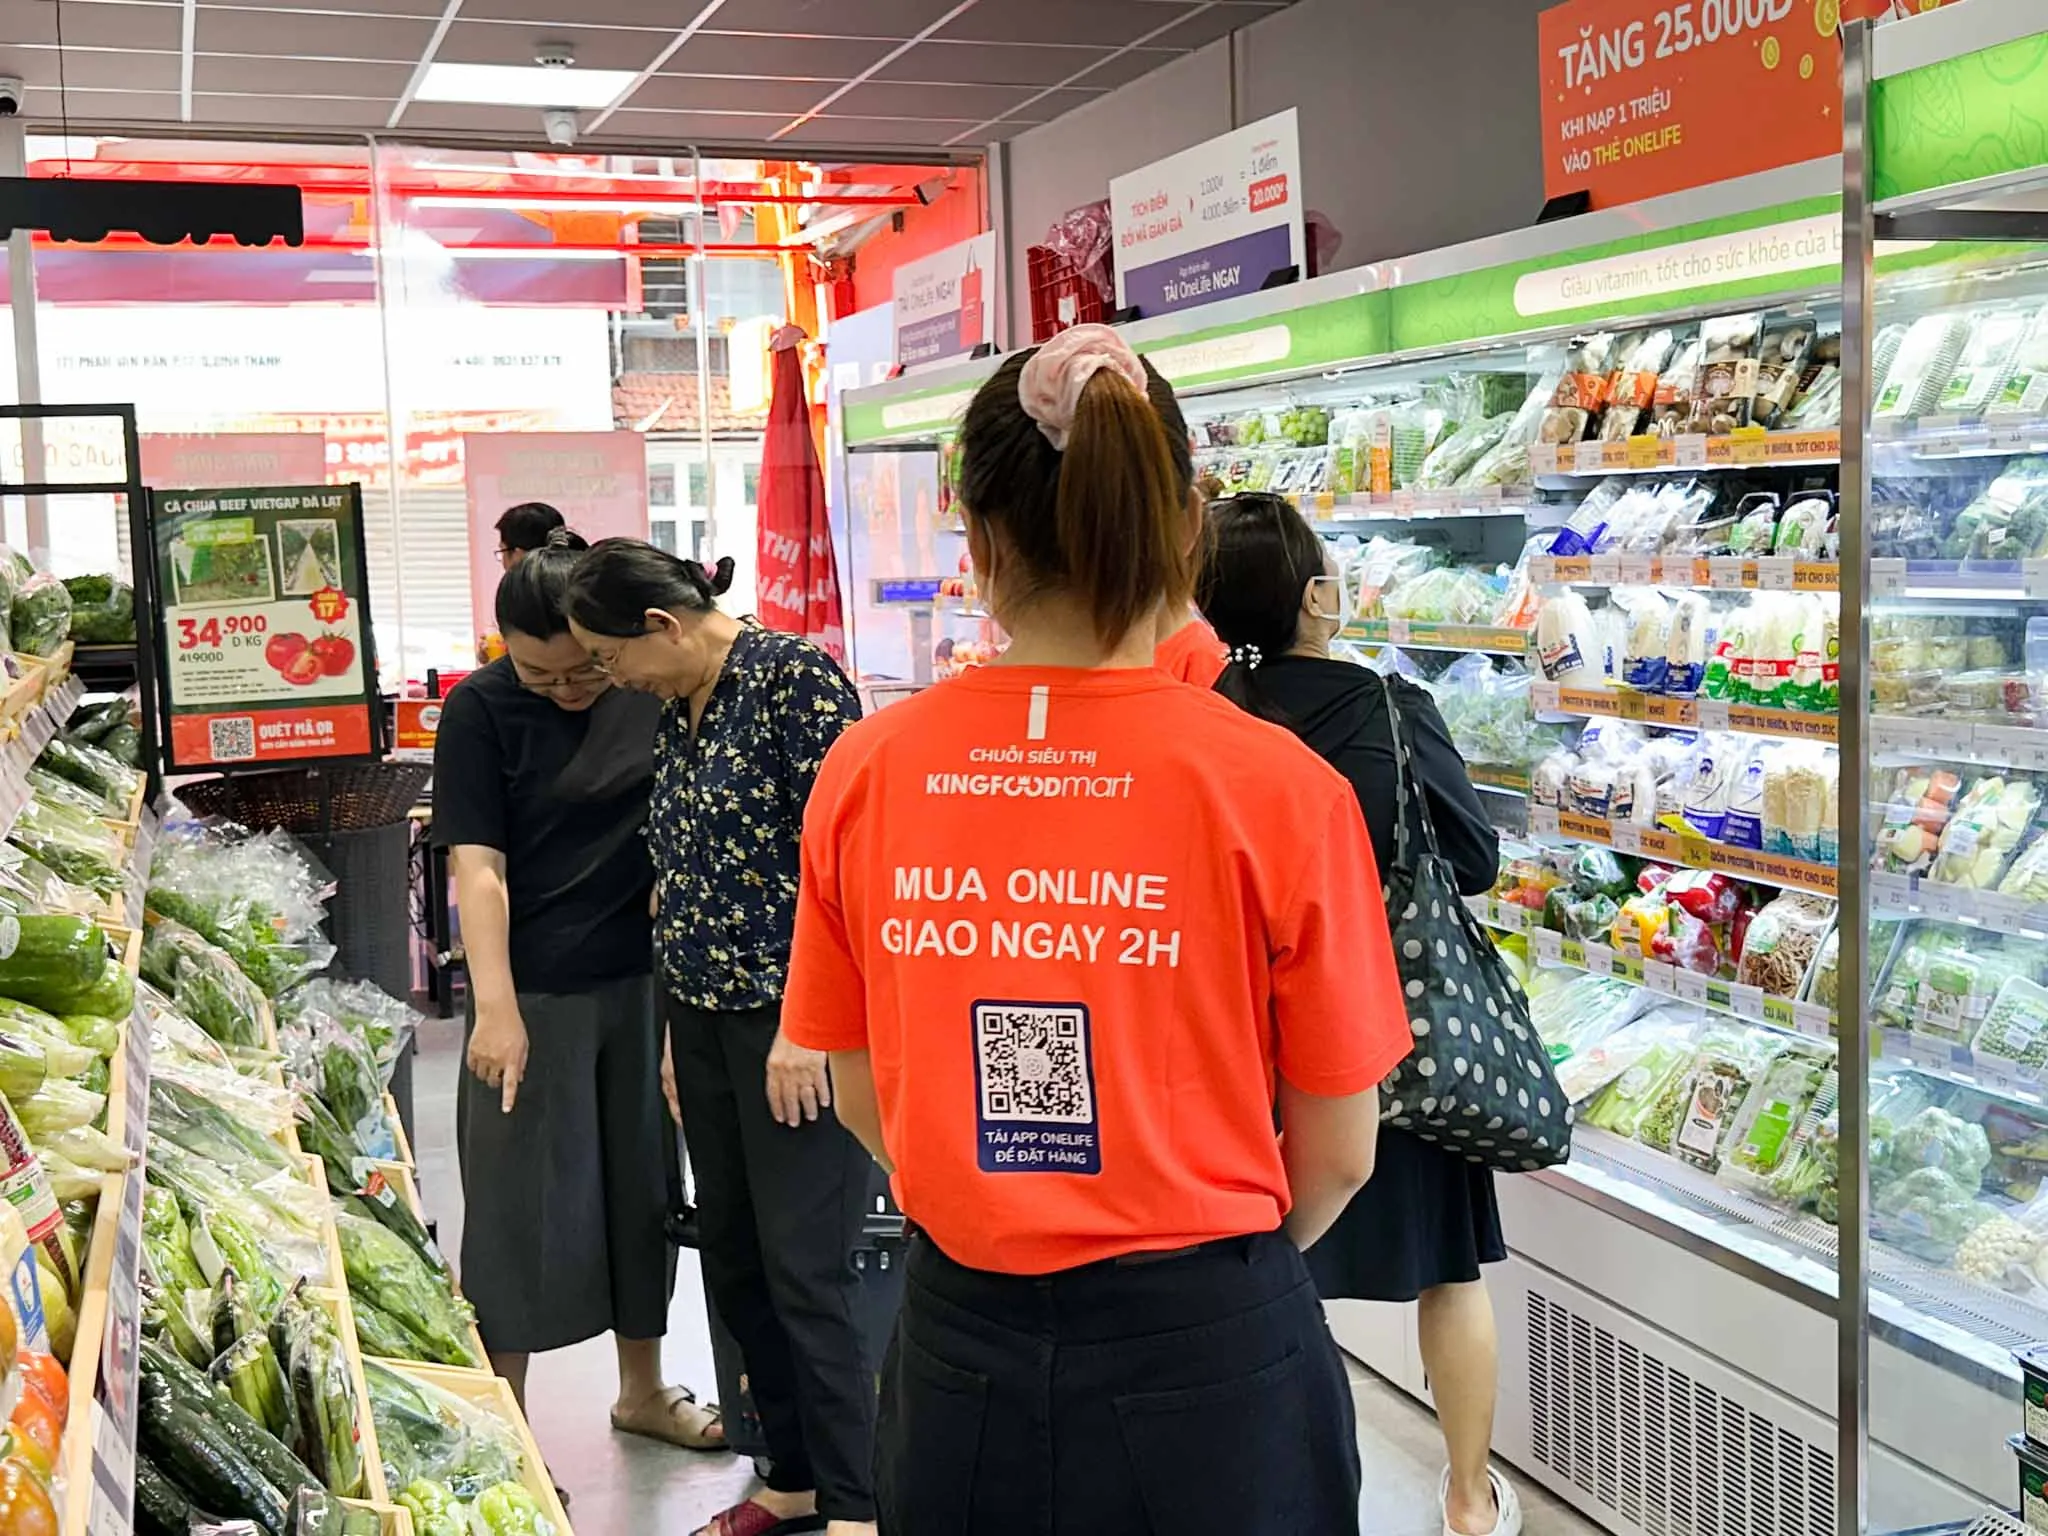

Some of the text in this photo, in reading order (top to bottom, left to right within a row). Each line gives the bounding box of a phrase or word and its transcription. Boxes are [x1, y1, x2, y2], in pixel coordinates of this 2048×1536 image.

[1559, 25, 1646, 95] TẶNG
[1561, 87, 1671, 140] KHI NẠP 1 TRIỆU
[1563, 124, 1682, 174] VÀO THẺ ONELIFE
[1560, 274, 1592, 299] Giàu
[1593, 264, 1652, 293] vitamin,
[1656, 256, 1679, 286] tốt
[1683, 253, 1712, 277] cho
[1716, 246, 1744, 273] sức
[1796, 235, 1826, 259] của
[1163, 280, 1179, 303] TẢI
[1180, 274, 1211, 299] OneLife
[1212, 265, 1240, 290] NGAY
[1810, 440, 1825, 452] CHO
[183, 499, 217, 512] CHUA
[220, 498, 247, 511] BEEF
[250, 497, 300, 510] VIETGAP
[1808, 571, 1823, 583] CHO
[245, 636, 262, 647] KG
[259, 718, 334, 739] QUÉT MÃ QR
[969, 746, 1096, 767] CHUỖI SIÊU THỊ
[894, 867, 1169, 911] MUA ONLINE
[880, 918, 1182, 968] GIAO NGAY 2H
[984, 1127, 1094, 1147] TẢI APP ONELIFE
[994, 1146, 1087, 1167] ĐỂ ĐẶT HÀNG
